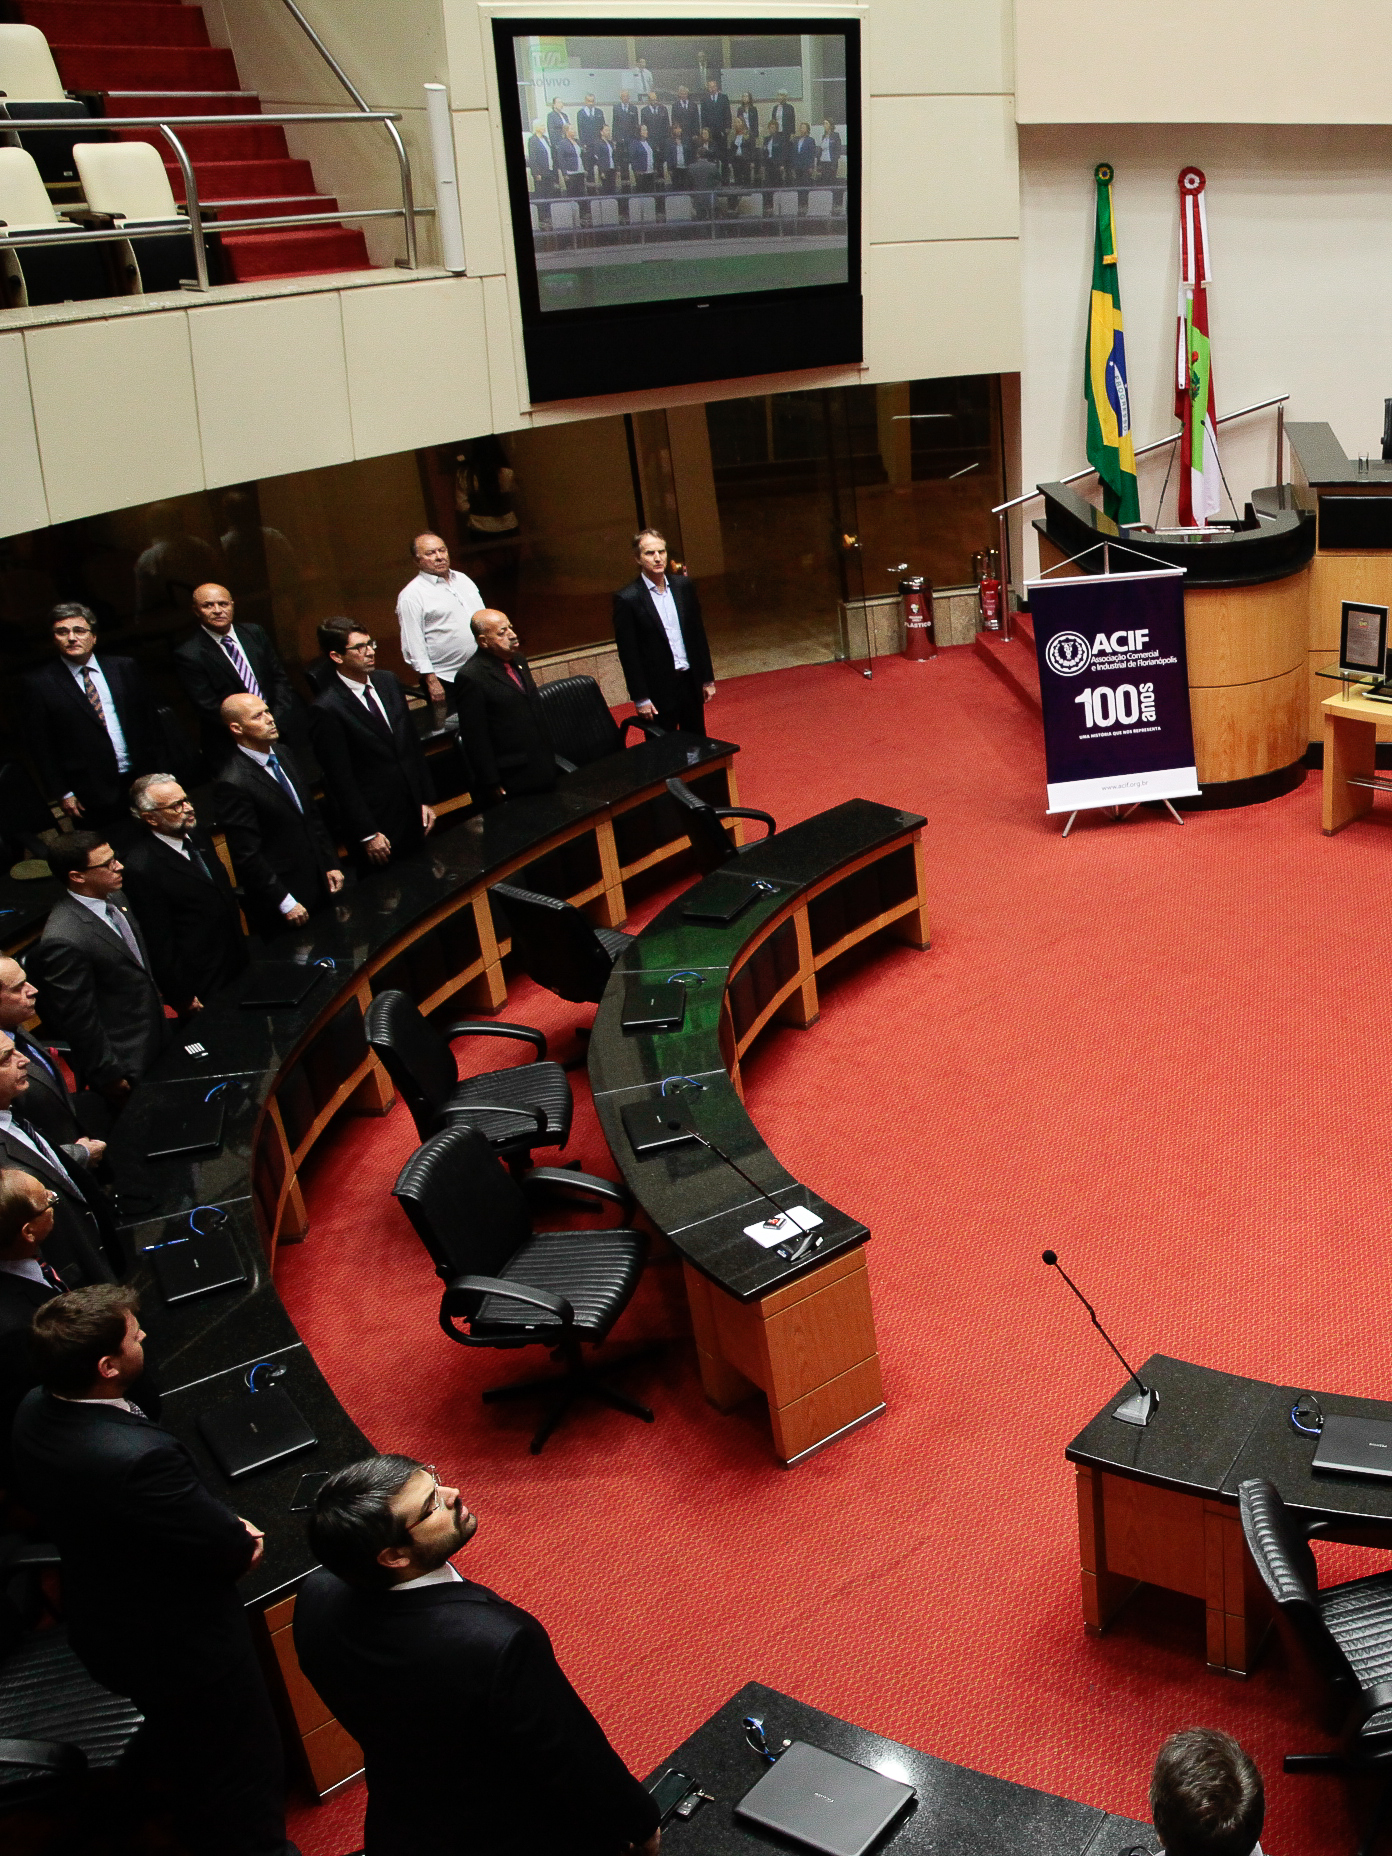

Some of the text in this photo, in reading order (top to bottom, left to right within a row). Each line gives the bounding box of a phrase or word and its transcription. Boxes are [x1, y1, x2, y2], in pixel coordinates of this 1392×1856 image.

[545, 78, 570, 87] VIVO
[1115, 375, 1129, 431] PROGRESSO
[1091, 629, 1150, 654] ACIF
[1091, 650, 1159, 664] Associação Comercial
[1097, 661, 1126, 671] Industrial
[1128, 660, 1136, 668] de
[1137, 656, 1178, 667] Florianópolis
[1075, 684, 1139, 728] 100
[1139, 682, 1157, 722] anos
[1133, 726, 1162, 734] REPRESENTA
[1101, 780, 1149, 791] www.acif.org.br
